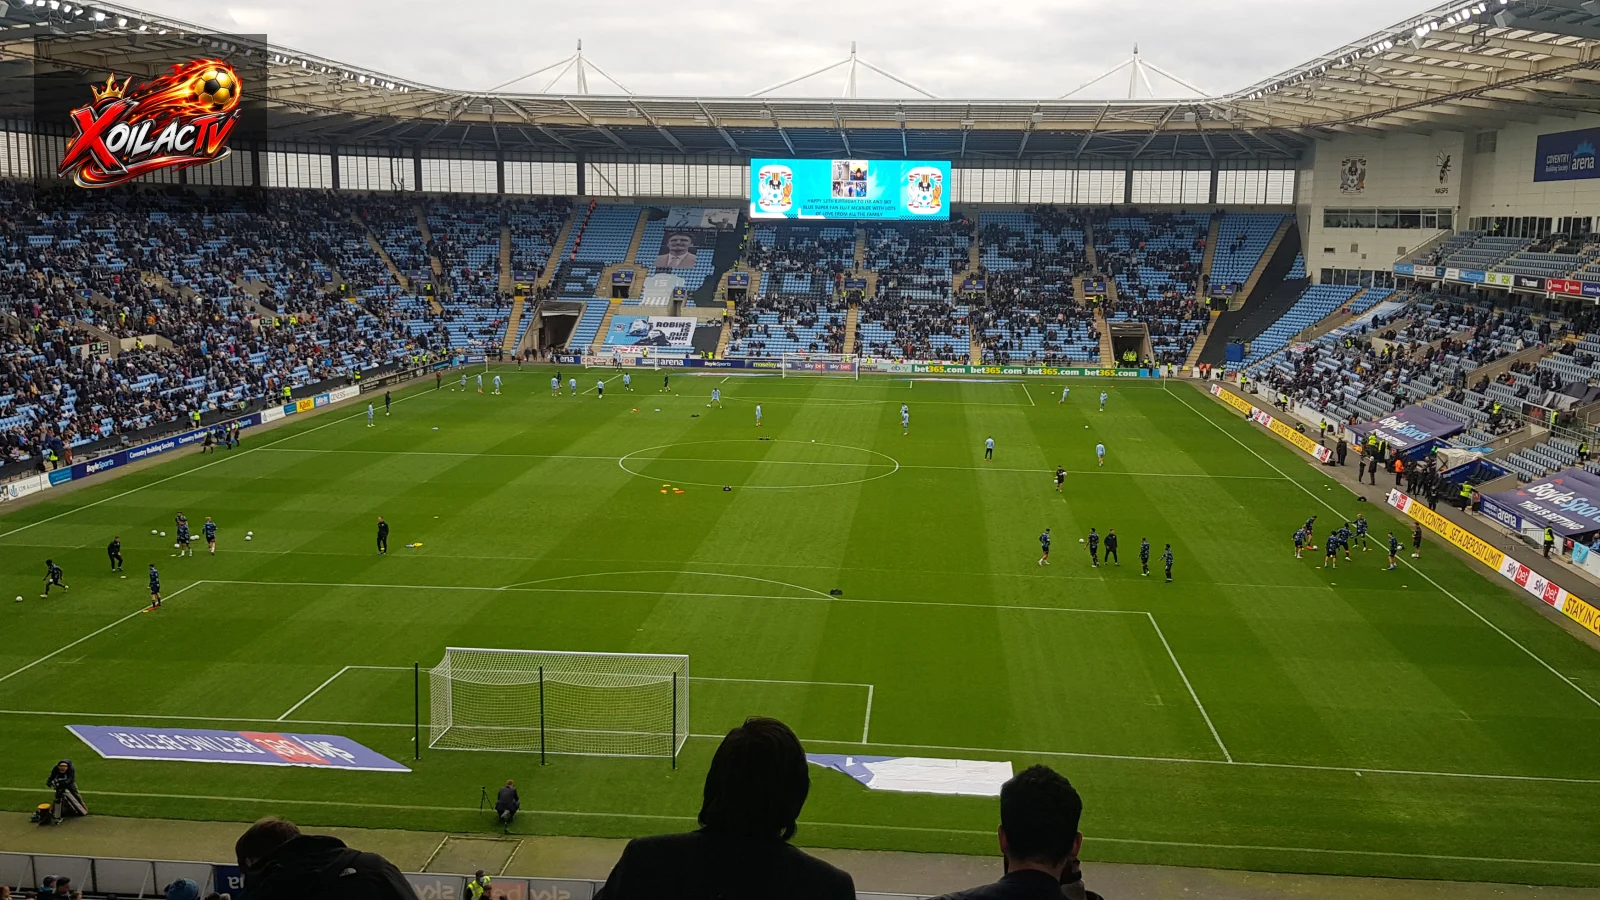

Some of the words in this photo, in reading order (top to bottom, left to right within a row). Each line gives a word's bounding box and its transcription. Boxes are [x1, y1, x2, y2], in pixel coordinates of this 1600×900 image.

[1546, 153, 1570, 164] COVENTRY
[1571, 156, 1595, 170] arena
[914, 365, 966, 374] bet365.com
[971, 366, 1022, 375] bet365.com
[1028, 367, 1080, 375] bet365.com
[1085, 368, 1137, 377] bet365.com
[179, 434, 194, 444] Coventry
[129, 450, 147, 459] Coventry
[146, 446, 162, 454] Building
[161, 441, 174, 450] Society
[86, 459, 114, 472] BoyleSports
[1391, 492, 1399, 505] sky
[1528, 483, 1600, 524] BoyleSpor
[1497, 509, 1516, 528] arena
[1518, 500, 1543, 512] THIS
[1542, 513, 1584, 530] BETTING
[1409, 503, 1422, 518] STAY
[1420, 510, 1427, 520] IN
[1425, 512, 1448, 535] CONTROL
[1450, 527, 1461, 542] SET
[1462, 535, 1487, 558] DEPOSIT
[1484, 548, 1502, 567] LIMIT
[1507, 562, 1518, 578] sky
[1517, 569, 1528, 582] bet
[1534, 578, 1545, 595] sky
[1546, 587, 1557, 600] bet
[1566, 598, 1585, 620] STAY
[1583, 609, 1594, 625] IN
[108, 732, 178, 751] BETTER
[175, 734, 265, 754] BETTING
[292, 736, 355, 763] sky
